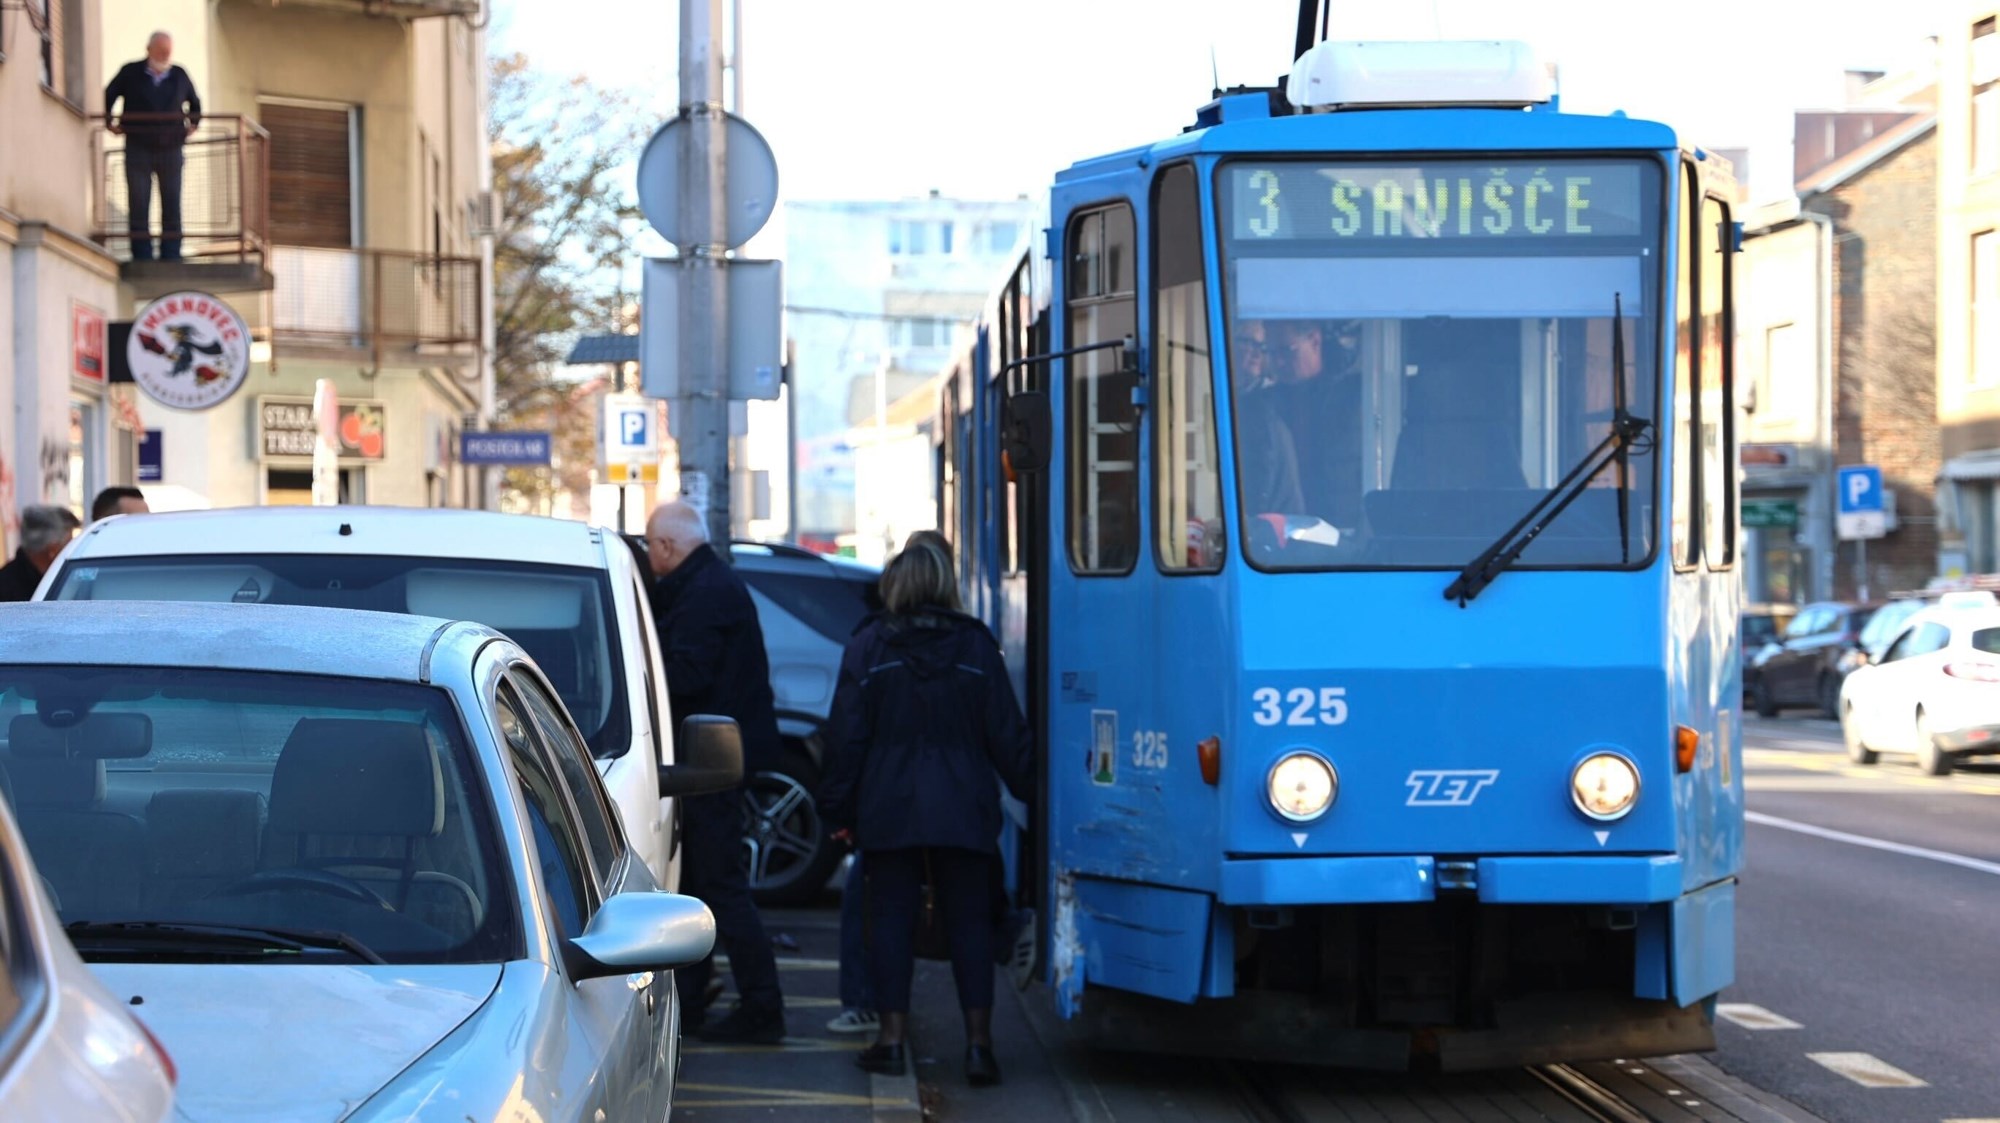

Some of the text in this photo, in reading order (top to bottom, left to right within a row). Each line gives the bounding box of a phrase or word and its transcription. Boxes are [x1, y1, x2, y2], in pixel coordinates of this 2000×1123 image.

[1249, 167, 1592, 236] 3 SAVIŠĆE
[623, 412, 644, 444] P
[1848, 473, 1870, 506] P
[1252, 686, 1349, 726] 325
[1132, 730, 1168, 769] 325
[1405, 769, 1501, 807] ZET
